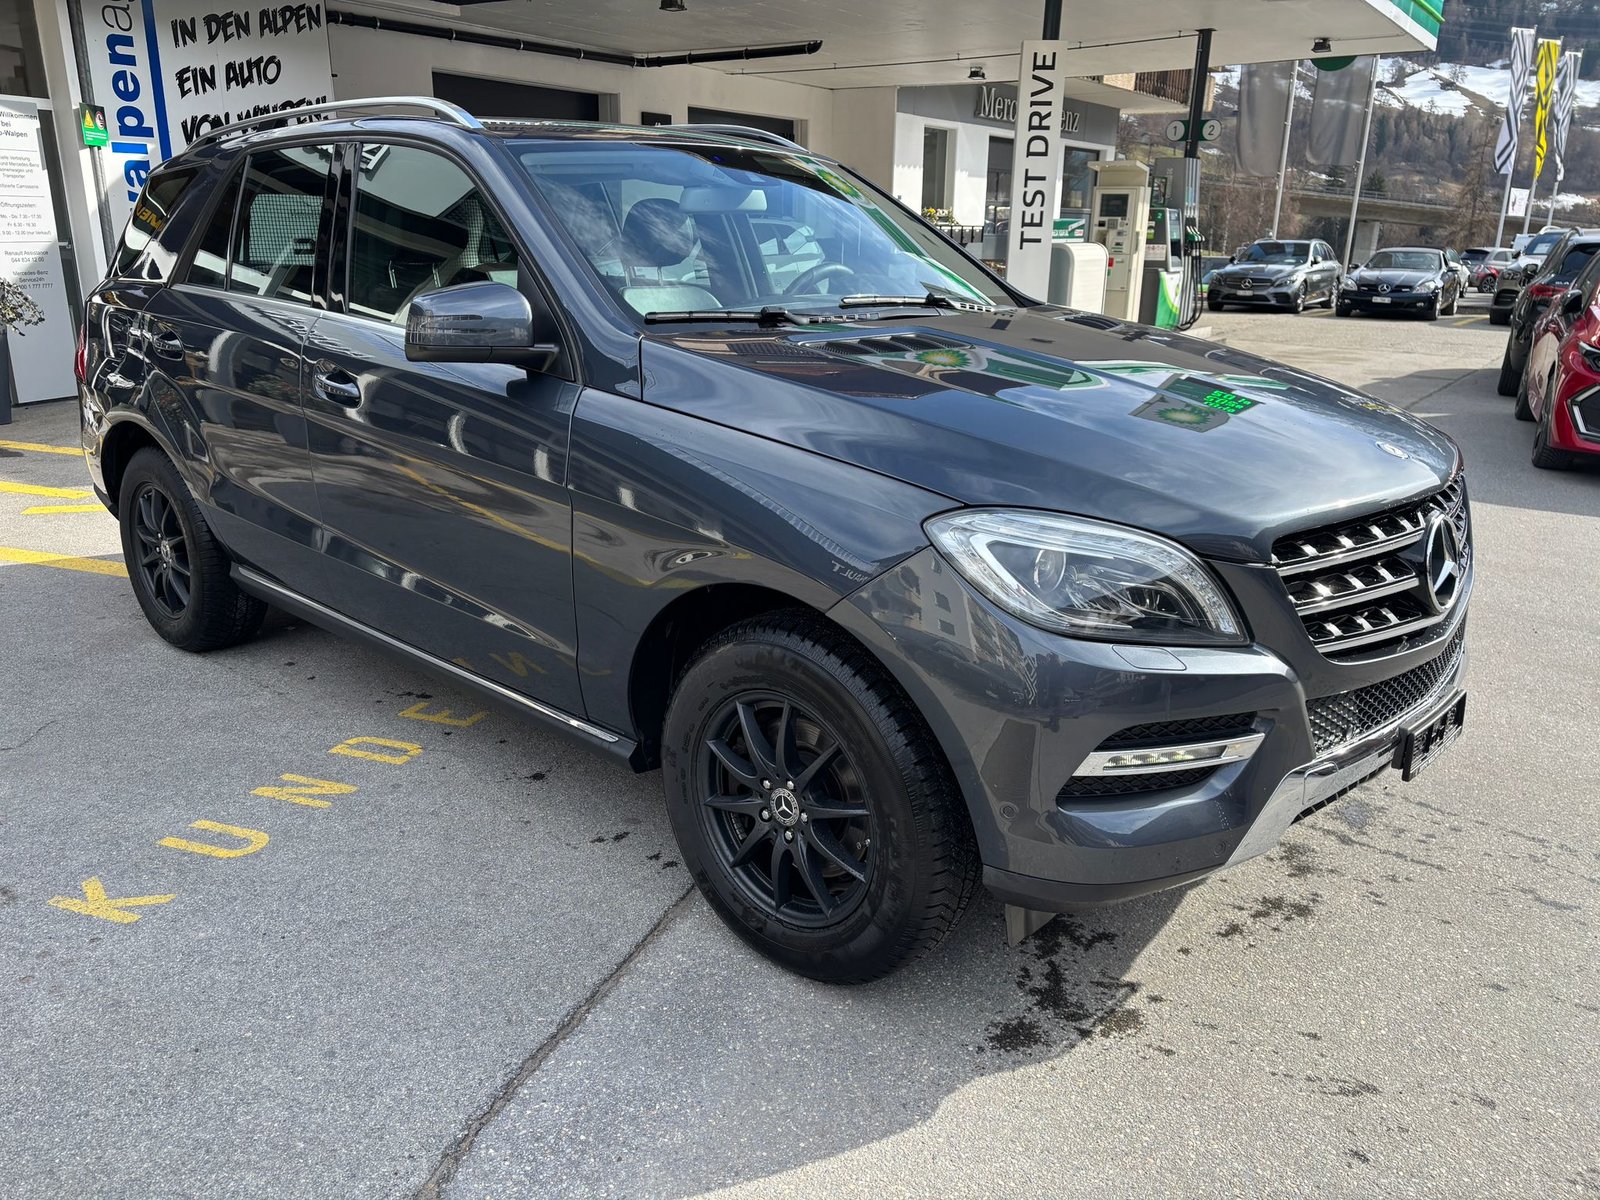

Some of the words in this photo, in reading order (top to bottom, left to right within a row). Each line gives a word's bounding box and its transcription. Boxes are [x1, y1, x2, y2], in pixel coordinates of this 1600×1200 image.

[171, 17, 197, 48] IN
[202, 11, 251, 44] DEN
[259, 3, 321, 38] ALPEN
[175, 65, 216, 99] EIN
[225, 55, 281, 92] AUTO
[1026, 52, 1056, 158] DRIVE
[1173, 125, 1178, 136] 1
[1208, 124, 1215, 135] 2
[1020, 168, 1047, 250] TEST
